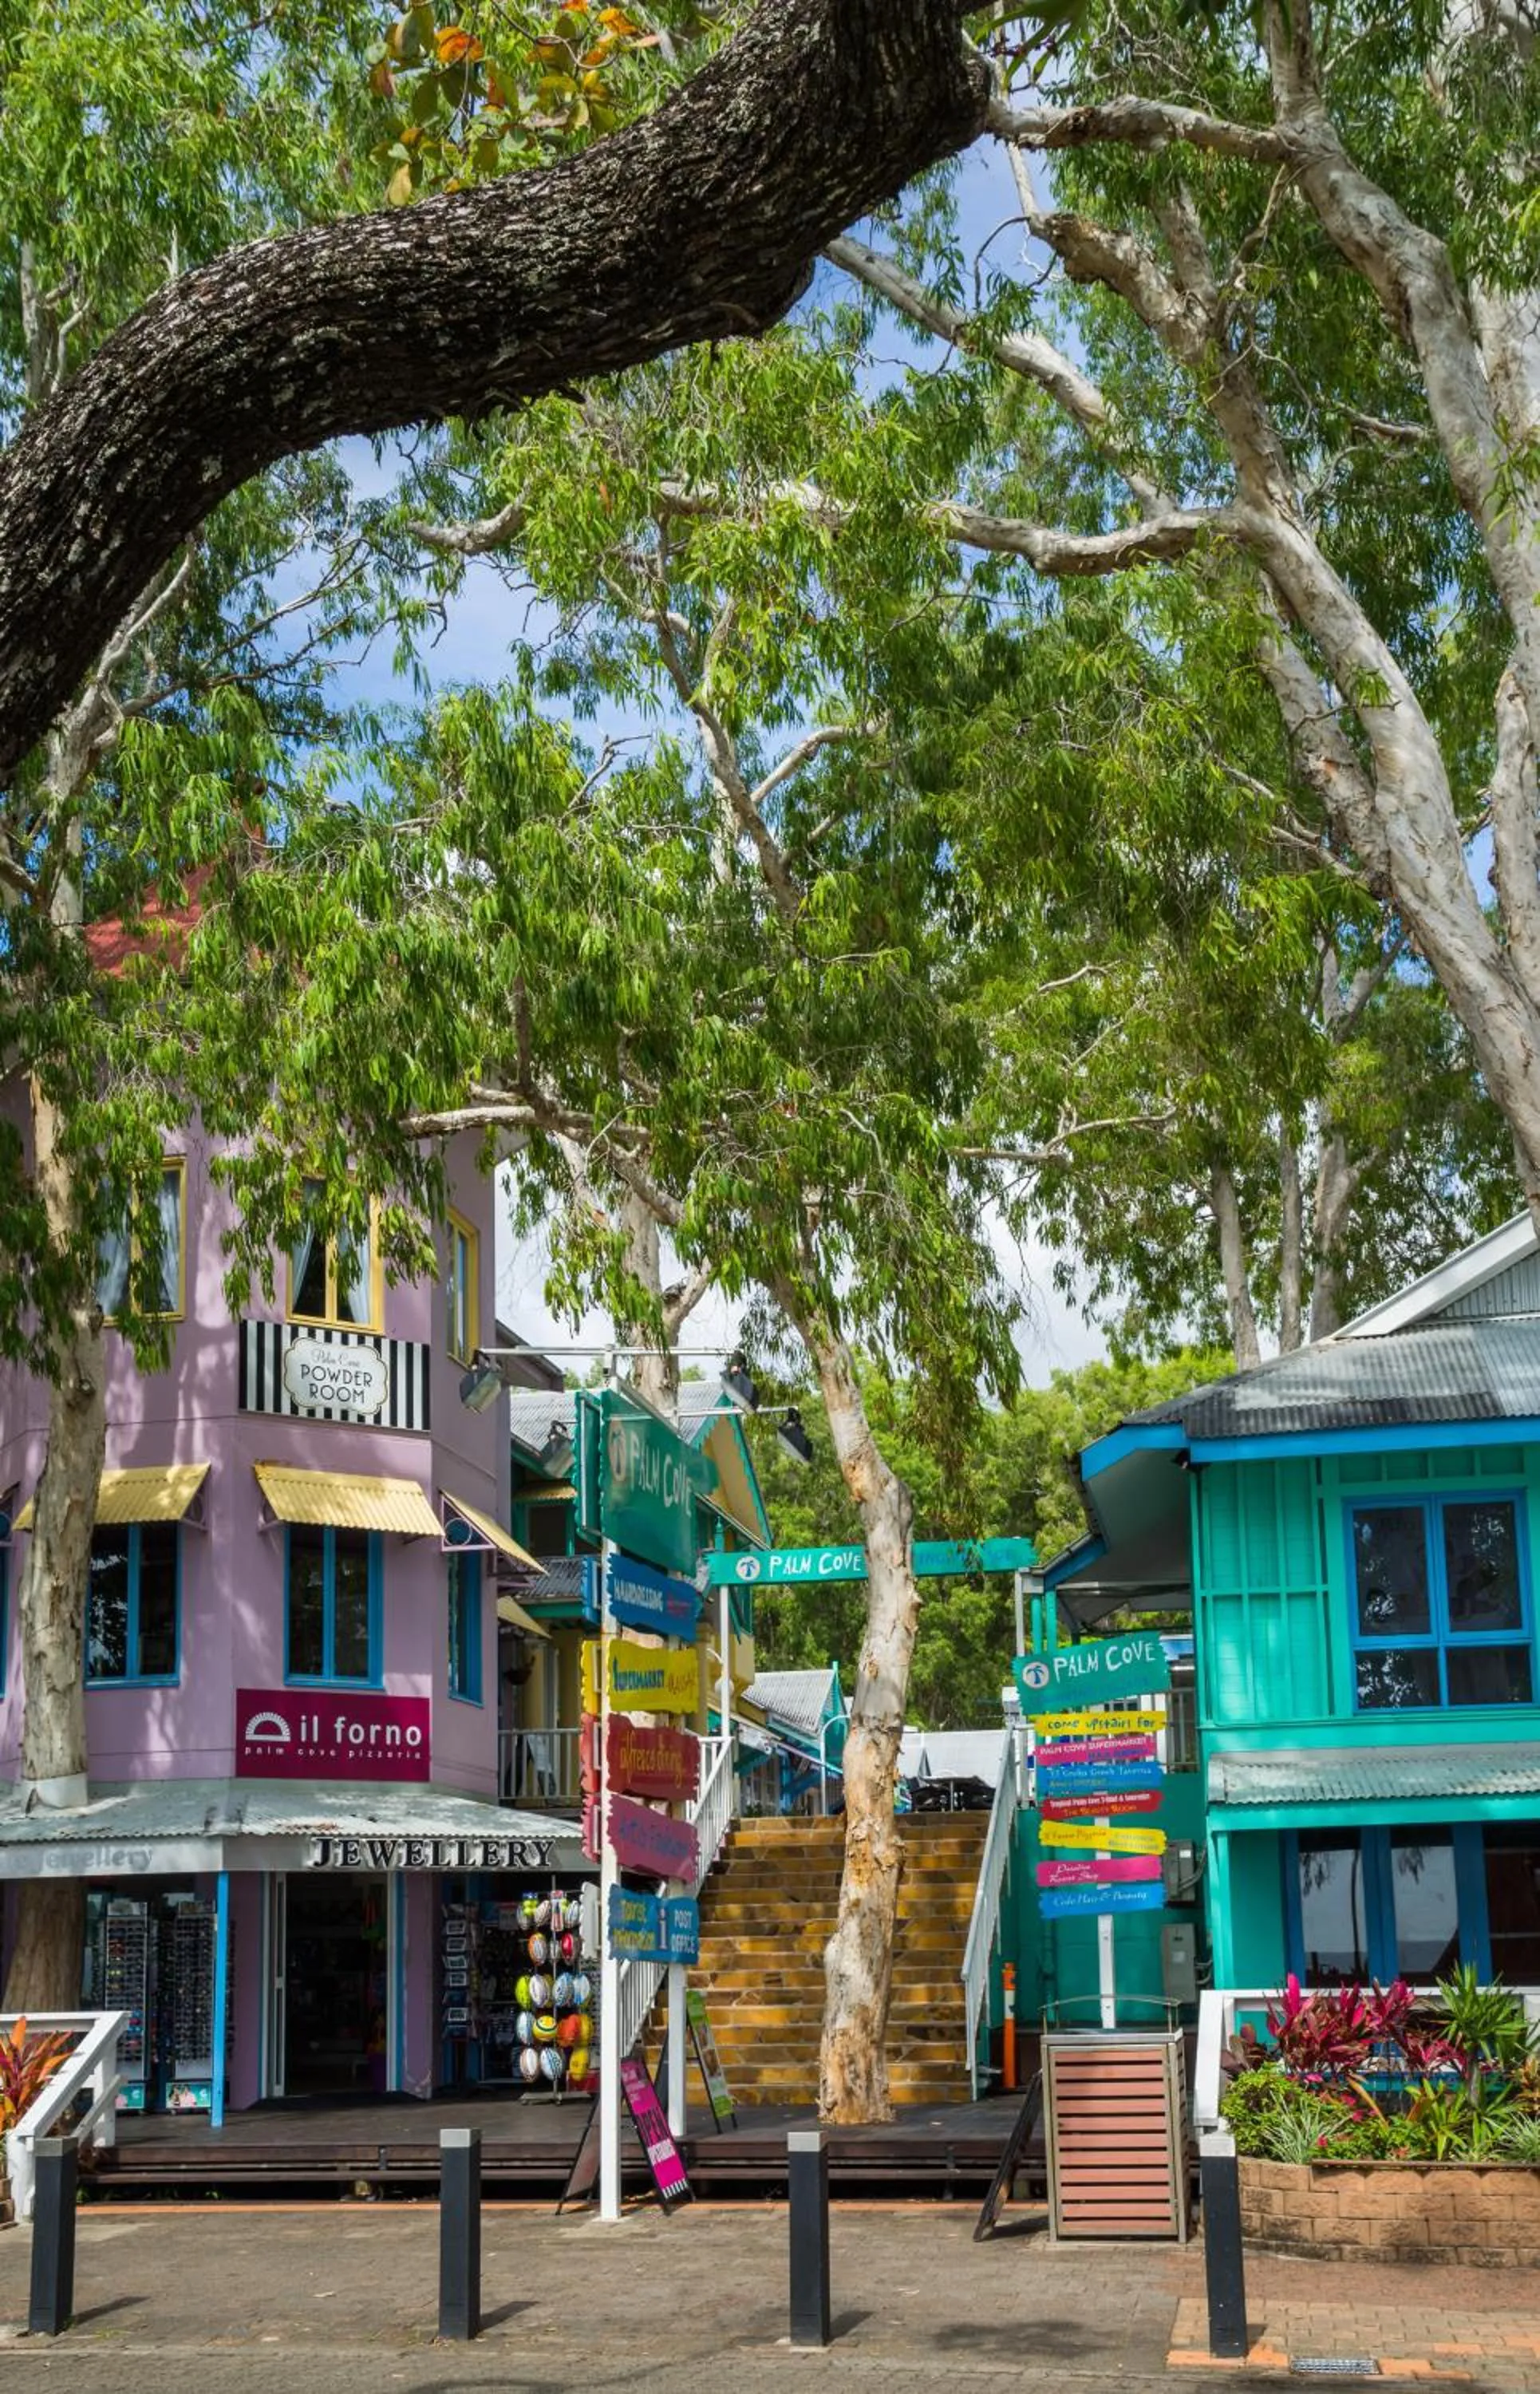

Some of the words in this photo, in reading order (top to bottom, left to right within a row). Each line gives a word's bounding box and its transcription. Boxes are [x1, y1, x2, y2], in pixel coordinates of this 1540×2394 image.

[300, 1364, 373, 1387] POWDER
[309, 1383, 365, 1404] ROOM
[630, 1431, 660, 1495] PALM
[768, 1552, 811, 1577] PALM
[819, 1551, 863, 1575] COVE
[1052, 1649, 1099, 1684] PALM
[1105, 1640, 1156, 1672] COVE
[300, 1715, 318, 1743] il
[334, 1716, 422, 1746] forno
[244, 1745, 285, 1756] palm
[298, 1748, 336, 1757] cove
[349, 1749, 422, 1759] pizzeria
[1040, 1747, 1062, 1756] PALM
[1064, 1744, 1087, 1753] COVE
[313, 1837, 555, 1867] JEWELLERY
[674, 1909, 693, 1929] POST
